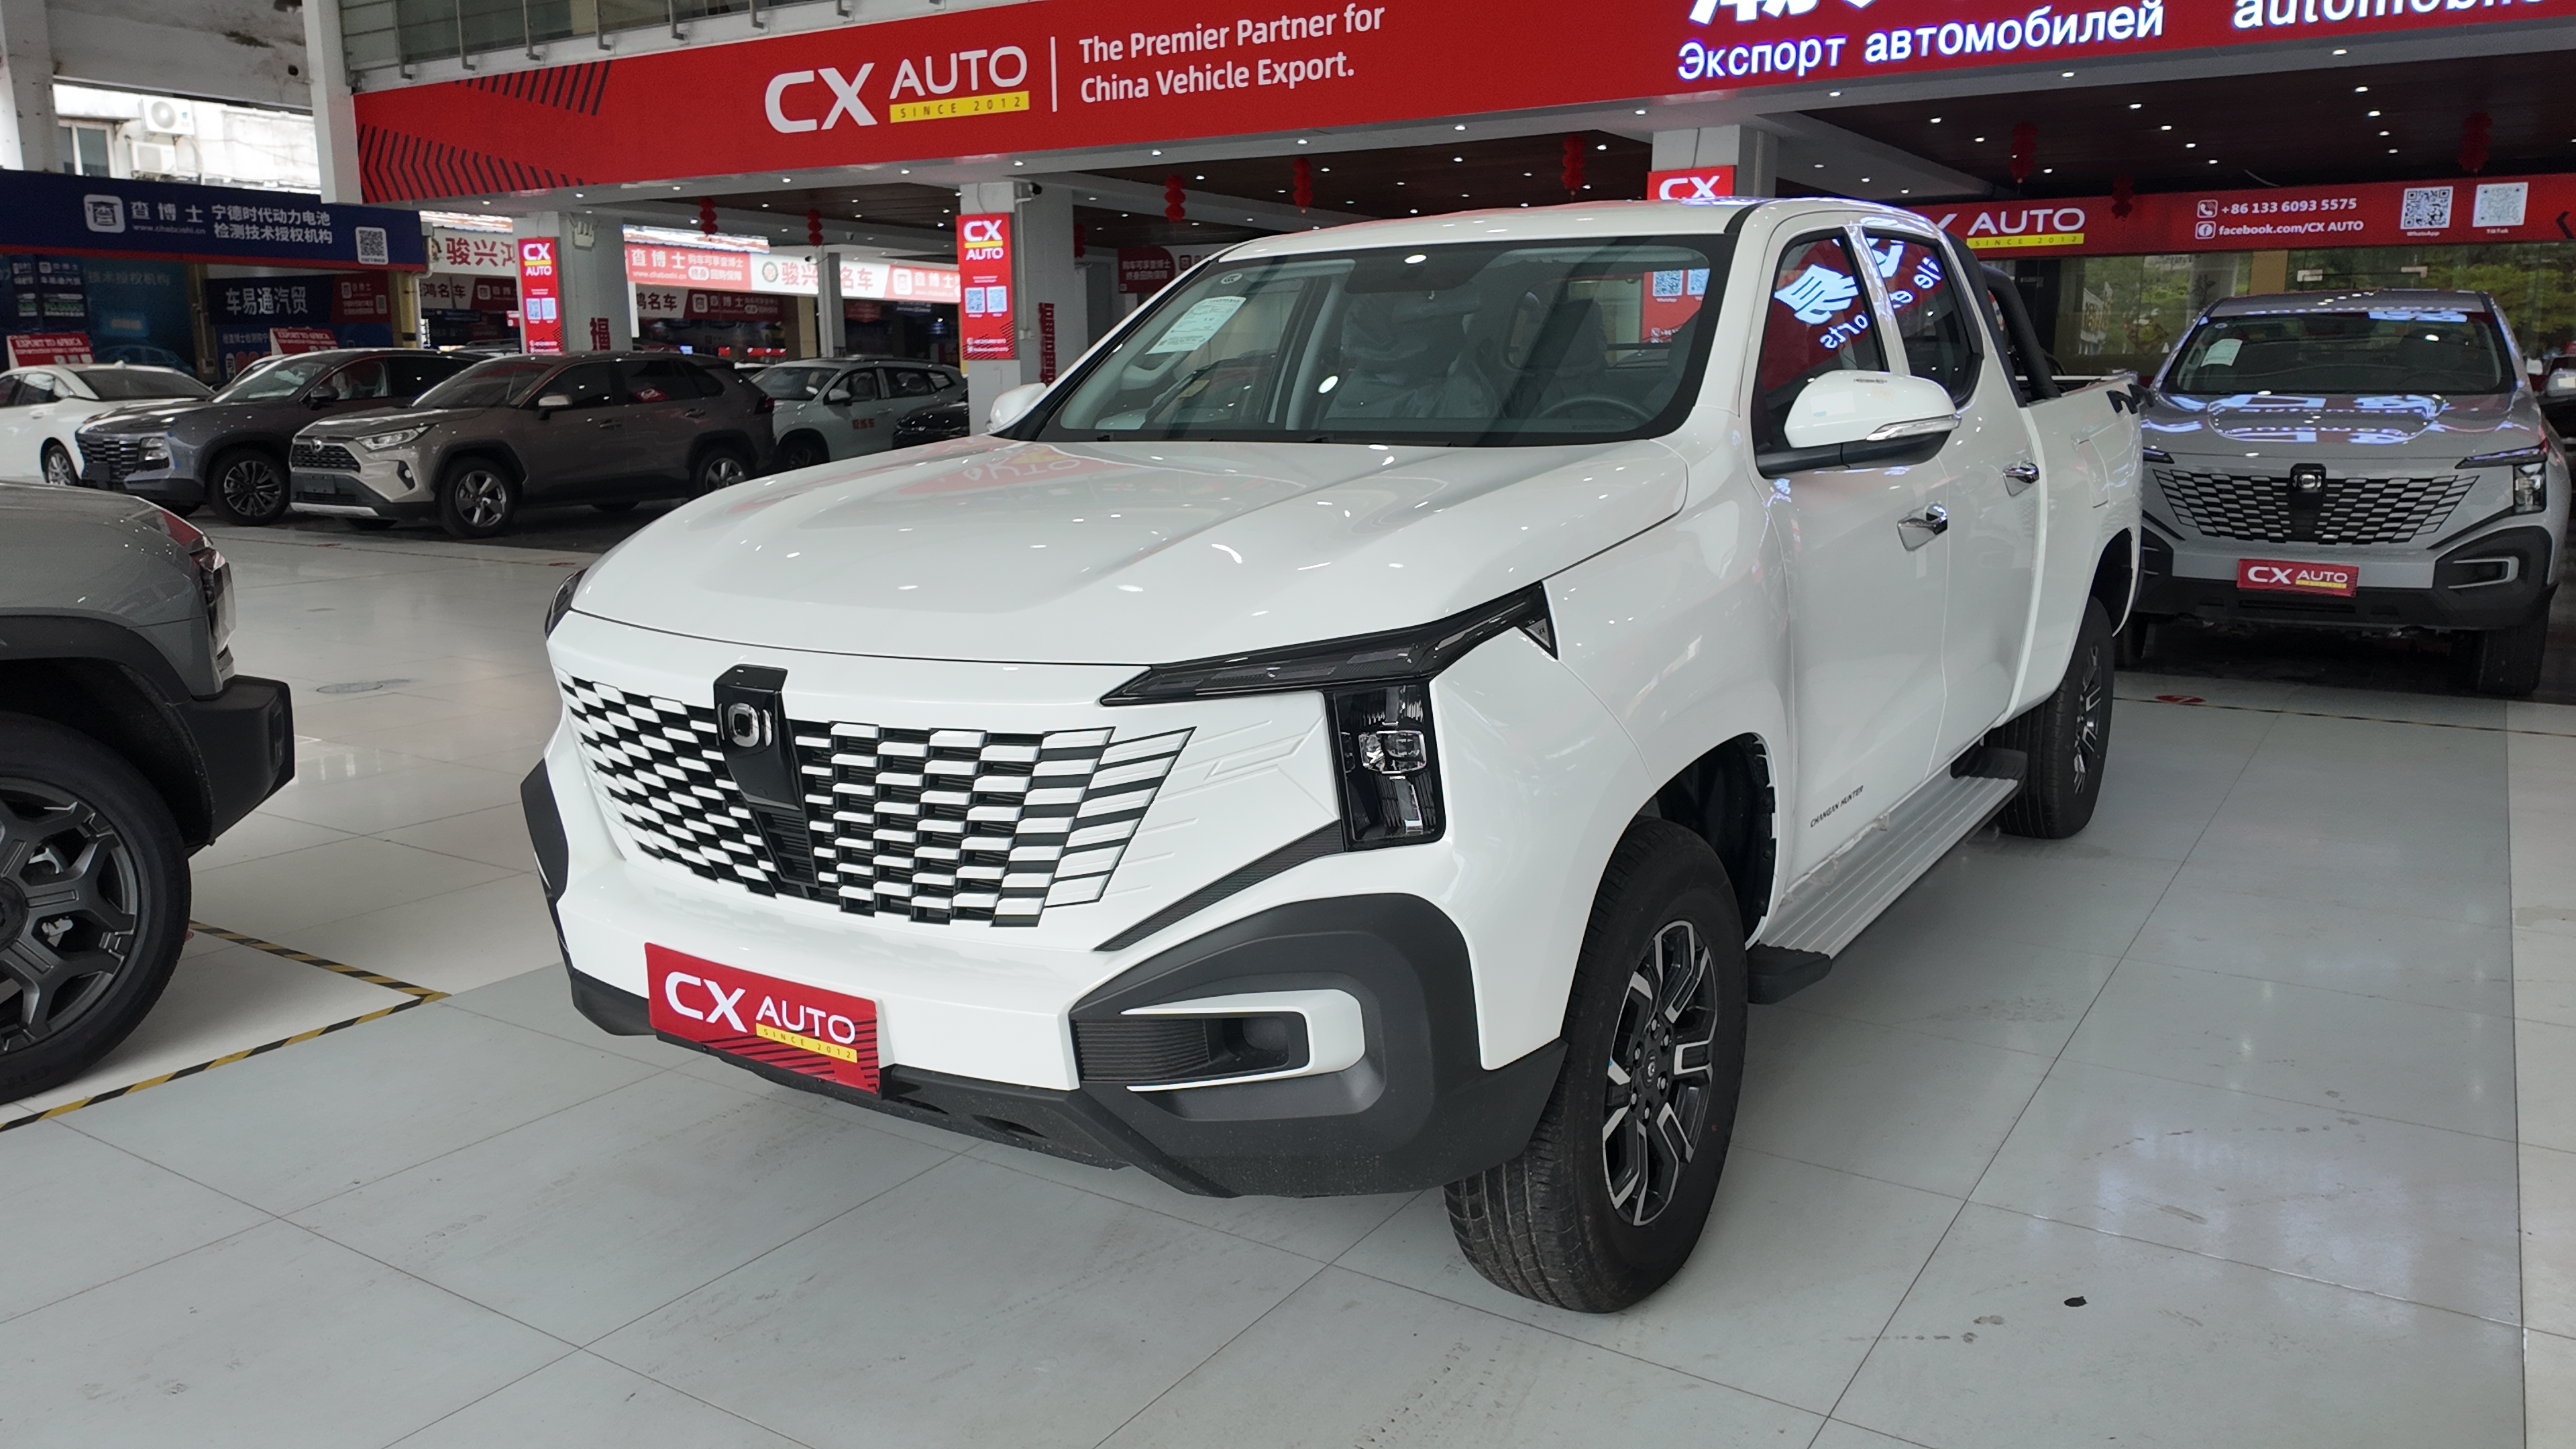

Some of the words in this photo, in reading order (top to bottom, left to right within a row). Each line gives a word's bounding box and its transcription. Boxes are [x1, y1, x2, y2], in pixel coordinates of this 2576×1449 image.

[1079, 36, 1124, 64] The
[1130, 23, 1230, 58] Premier
[1236, 12, 1338, 46] Partner
[1343, 3, 1386, 34] for
[1677, 37, 1847, 80] Экспорт
[1864, 0, 2165, 64] автомобилей
[1080, 73, 1150, 103] China
[1155, 62, 1250, 96] Vehicle
[1257, 52, 1355, 89] Export.
[764, 62, 878, 134] CX
[889, 46, 1028, 99] AUTO
[900, 103, 958, 119] SINCE
[973, 96, 1022, 112] 2012
[1658, 174, 1721, 201] CX
[130, 201, 204, 224] 查博士
[211, 204, 331, 227] 宁德时代动力电池
[2220, 203, 2249, 215] +86
[2251, 201, 2278, 214] 133
[2281, 199, 2318, 213] 6093
[2320, 197, 2357, 212] 5575
[963, 219, 1004, 242] CX
[1967, 207, 2086, 236] AUTO
[2218, 221, 2325, 236] facebook.com/CX
[2327, 220, 2364, 233] AUTO
[213, 223, 333, 245] 检测技术授权机构
[1974, 237, 2024, 248] SINCE
[2037, 235, 2078, 244] 2012
[523, 243, 551, 261] CX
[631, 249, 686, 270] 查博士
[965, 248, 1004, 261] AUTO
[525, 266, 552, 276] AUTO
[781, 261, 874, 291] 骏兴名车
[225, 285, 309, 316] 车易通汽贸
[419, 282, 466, 299] 鸿名车
[2247, 566, 2294, 585] CX
[2296, 570, 2349, 584] AUTO
[664, 971, 748, 1033] CX
[755, 996, 856, 1044] AUTO
[763, 1028, 805, 1046] SINCE
[816, 1042, 852, 1059] 2012
